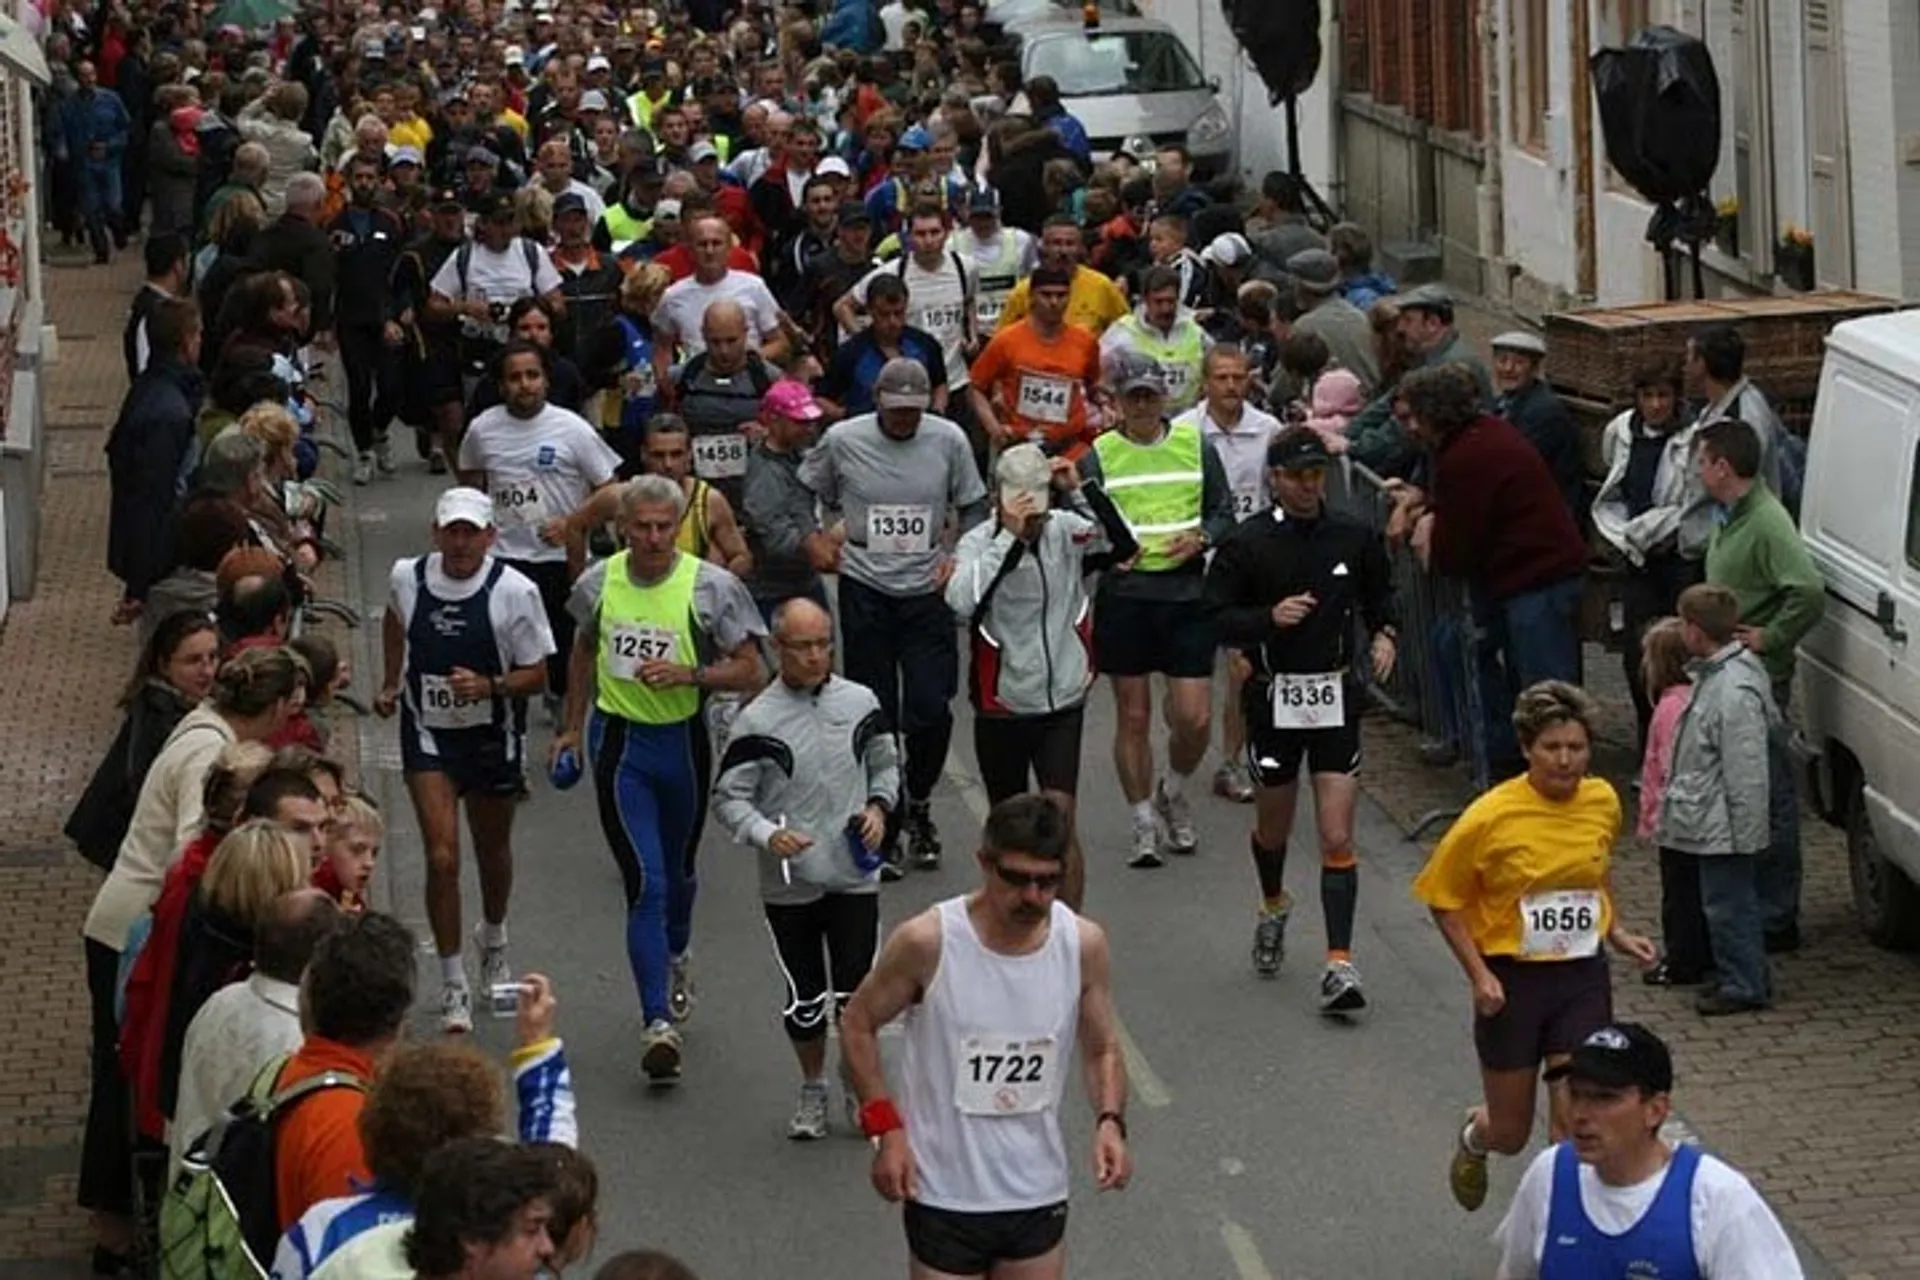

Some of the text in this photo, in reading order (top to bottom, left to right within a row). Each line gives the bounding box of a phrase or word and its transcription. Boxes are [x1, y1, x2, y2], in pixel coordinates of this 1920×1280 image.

[1023, 386, 1065, 405] 1544
[697, 446, 741, 462] 1458
[873, 517, 924, 535] 1330
[614, 635, 669, 659] 1257
[1280, 685, 1334, 706] 1336
[1530, 906, 1592, 931] 1656
[968, 1055, 1043, 1083] 1722
